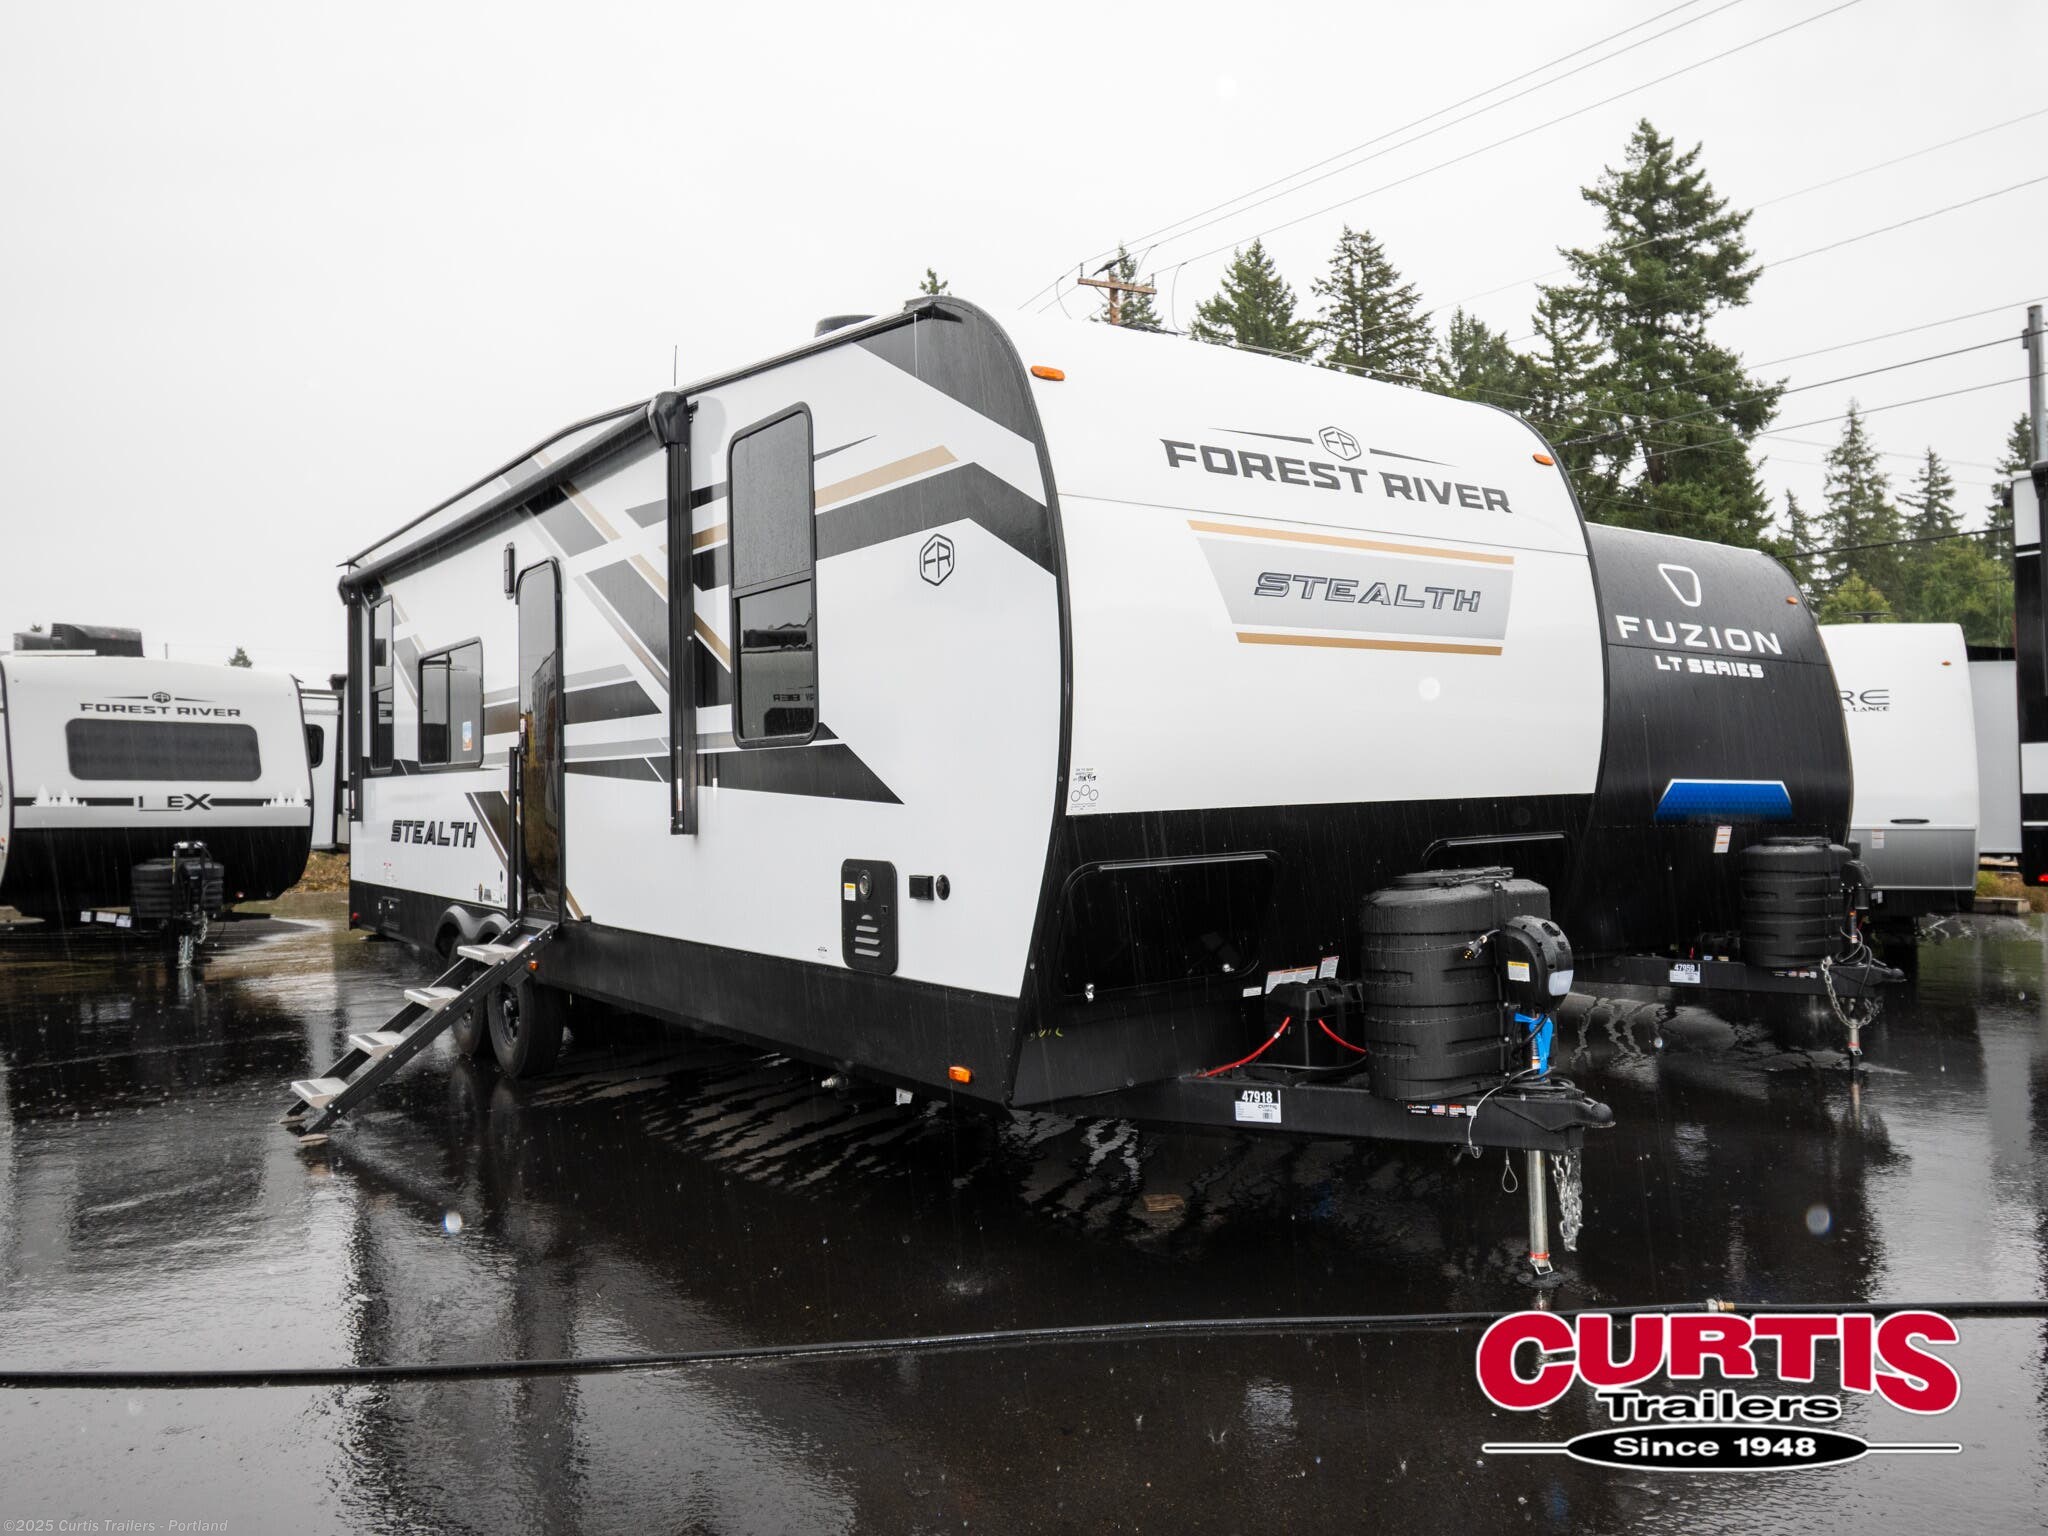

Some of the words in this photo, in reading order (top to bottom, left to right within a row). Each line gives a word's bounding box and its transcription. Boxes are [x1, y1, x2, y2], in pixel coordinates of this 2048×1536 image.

[1159, 438, 1368, 493] FOREST
[1378, 470, 1514, 513] RIVER
[1254, 571, 1481, 613] STEALTH
[1615, 615, 1783, 655] FUZION
[1655, 655, 1683, 671] LT
[1686, 658, 1765, 679] SERIES
[80, 703, 170, 715] FOREST
[177, 707, 241, 717] RIVER
[138, 793, 211, 811] IEX
[391, 819, 478, 848] STEALTH
[1242, 1090, 1273, 1103] 47918
